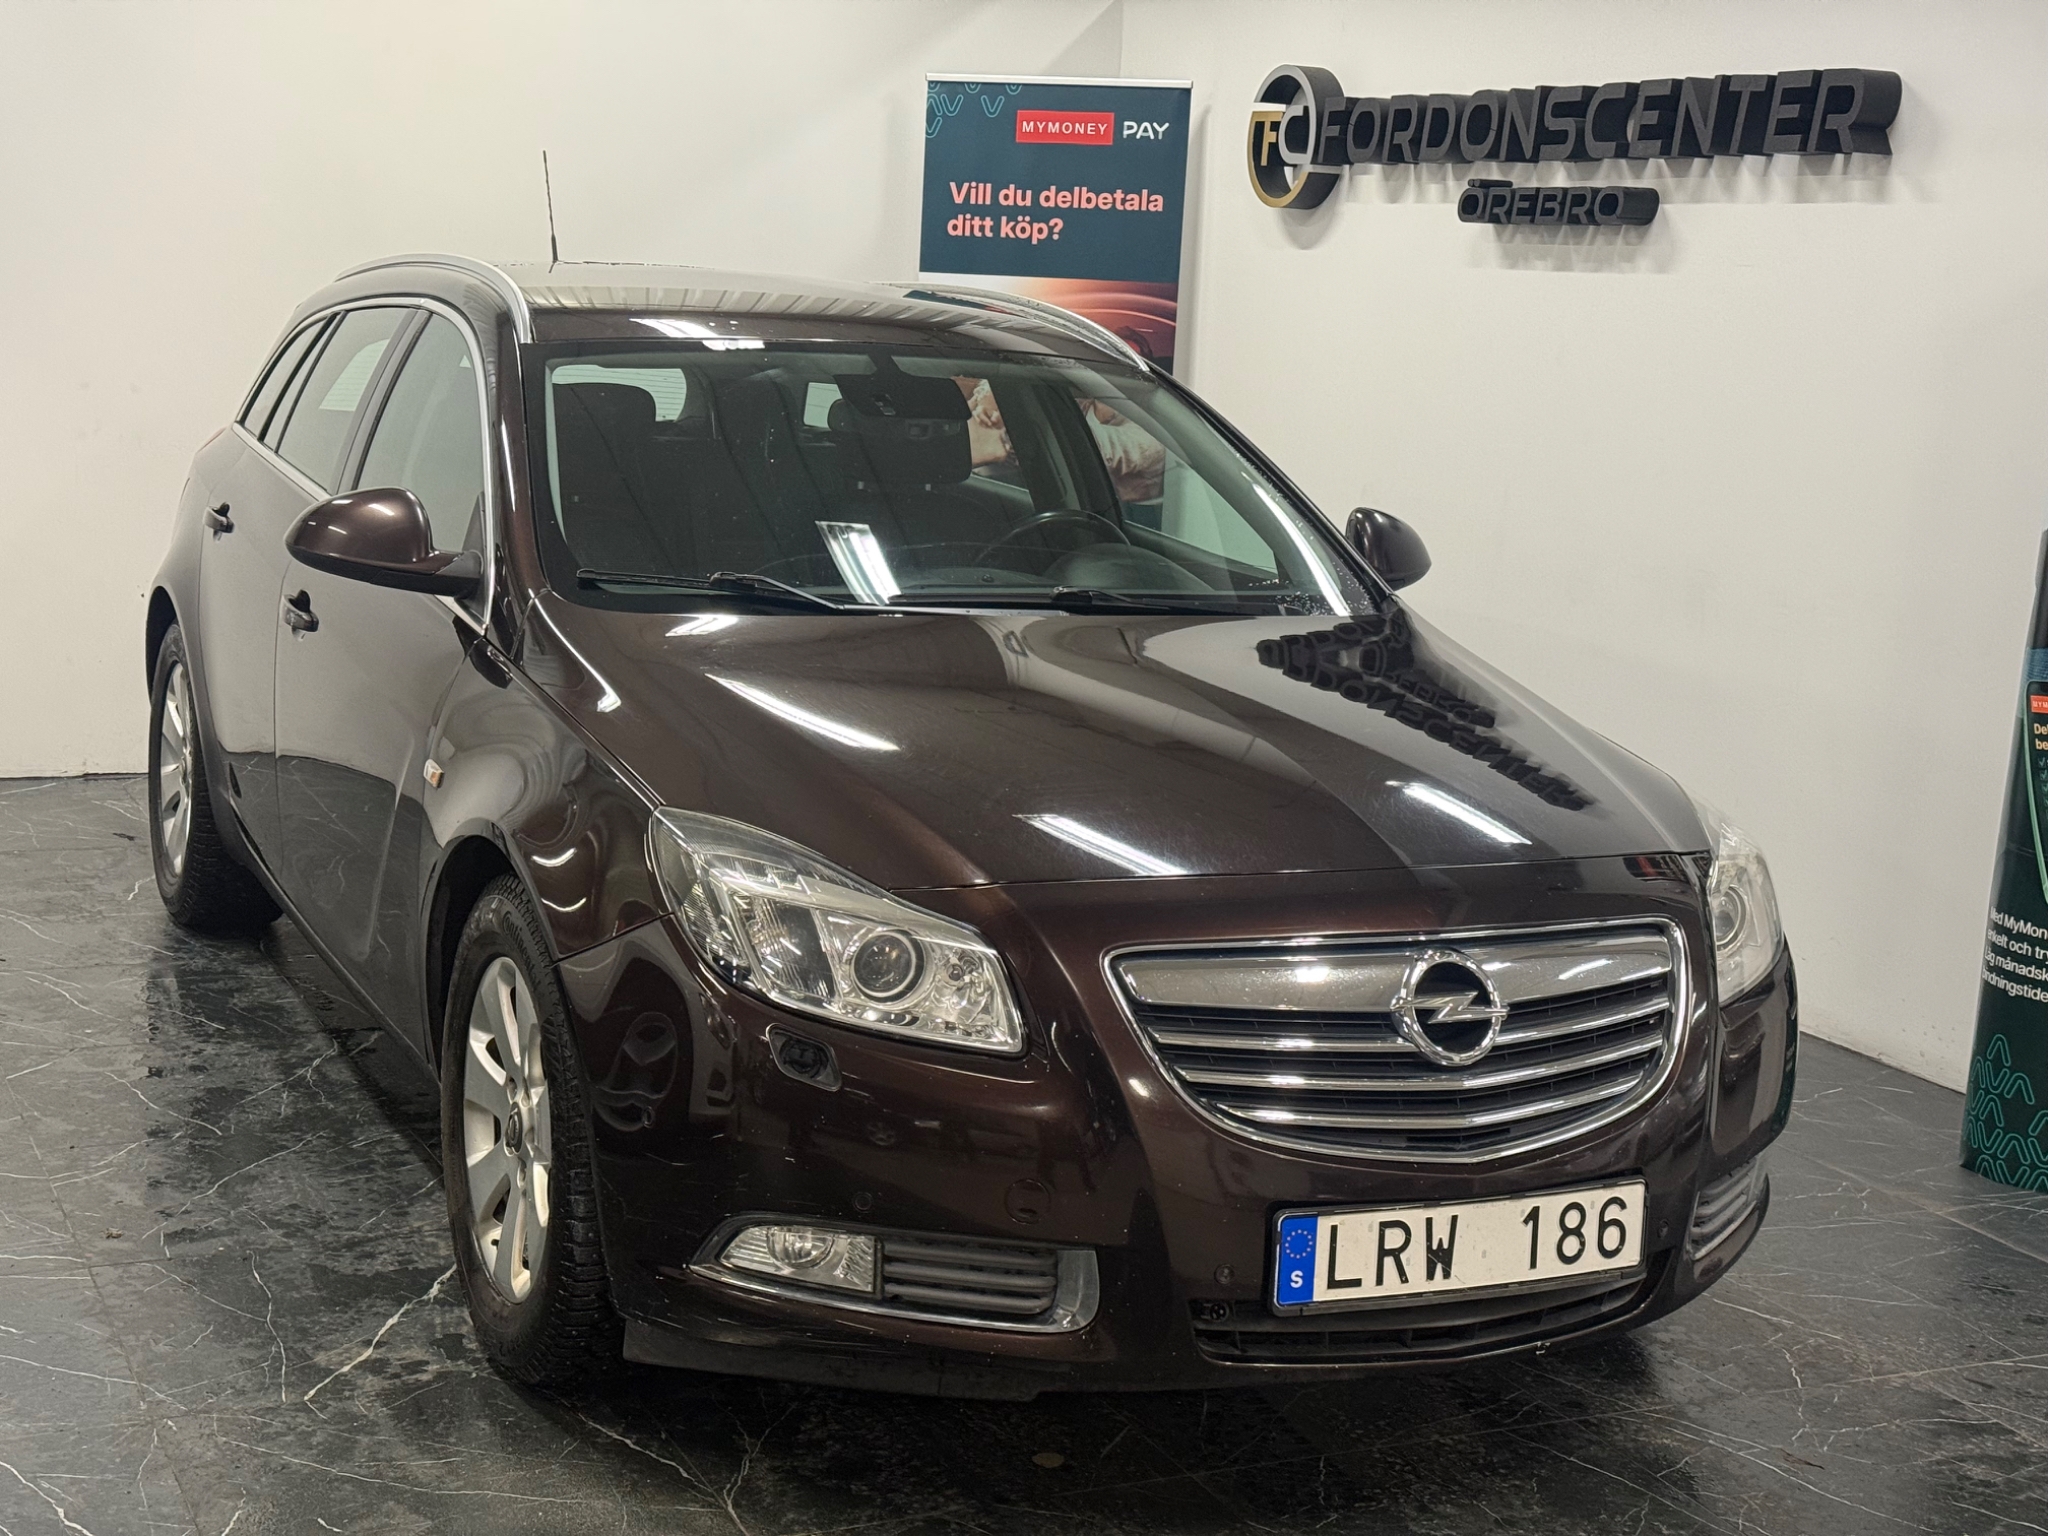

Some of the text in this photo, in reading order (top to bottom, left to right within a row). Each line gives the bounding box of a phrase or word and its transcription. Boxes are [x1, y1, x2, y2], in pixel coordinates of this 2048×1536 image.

[1022, 121, 1169, 139] MYMONEY PAY
[1317, 68, 1884, 165] FORDONSCENTER
[949, 182, 1164, 212] Vill du delbetala
[1458, 178, 1640, 226] ÖREBRO
[947, 213, 1064, 245] ditt köp?
[2009, 940, 2032, 957] och
[1327, 1197, 1626, 1289] LRW 186
[1290, 1270, 1304, 1288] S
